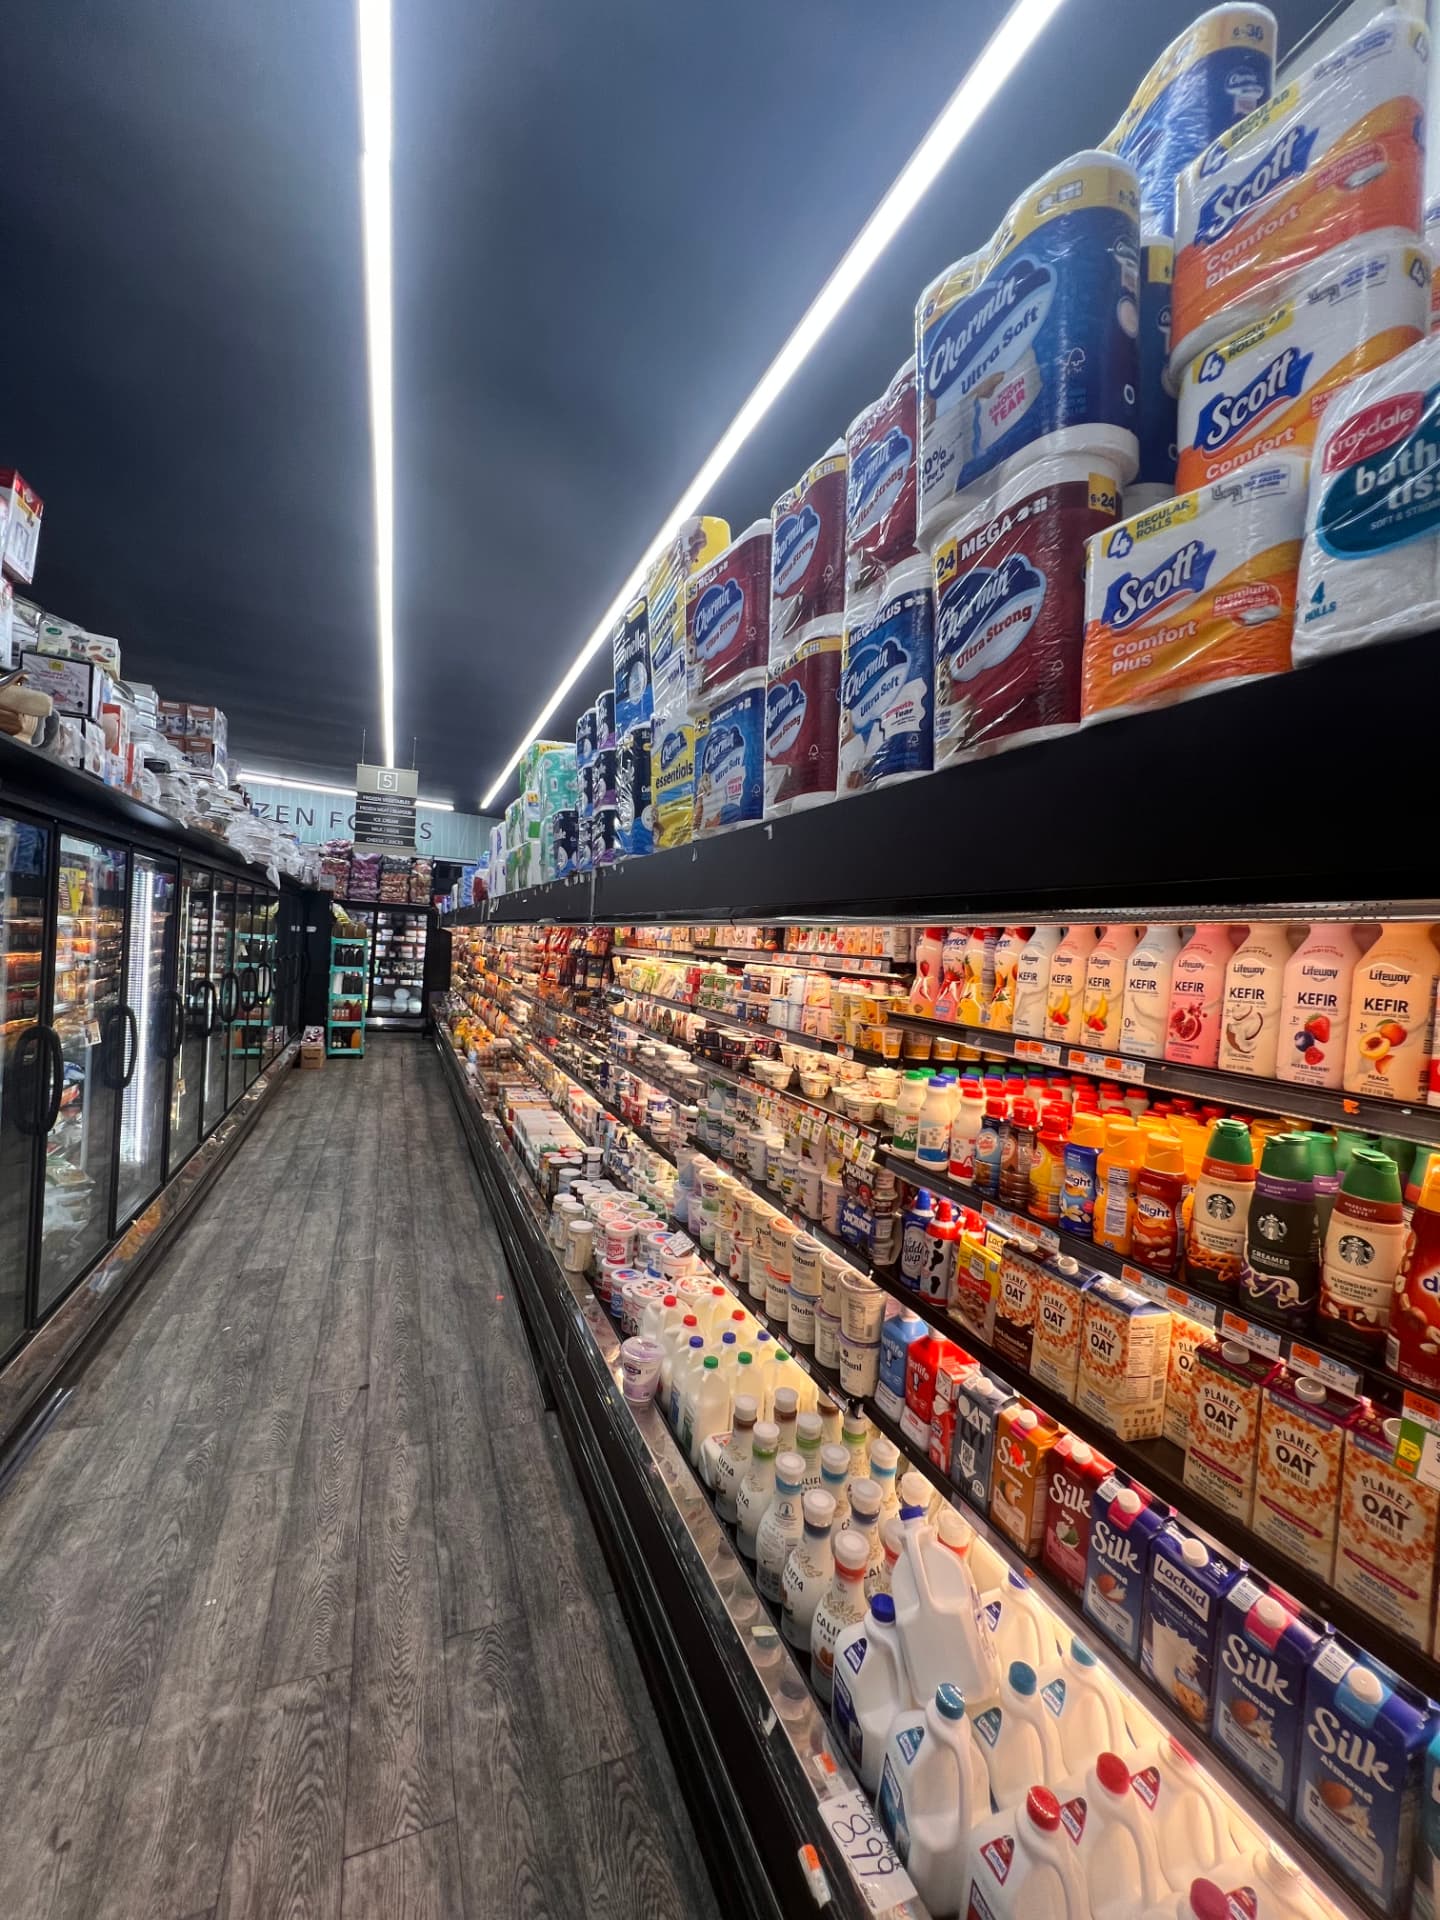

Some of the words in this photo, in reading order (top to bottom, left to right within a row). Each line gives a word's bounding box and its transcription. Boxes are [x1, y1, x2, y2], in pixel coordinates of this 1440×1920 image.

[1200, 140, 1227, 178] 4
[1206, 128, 1300, 236] Scott
[1206, 206, 1299, 271] Comfort
[1410, 257, 1426, 288] 4
[929, 277, 1017, 391] Charmin
[1228, 331, 1266, 359] ROLLS
[961, 350, 1001, 395] Ultra
[1002, 305, 1039, 349] Soft
[1199, 350, 1226, 383] 4
[991, 391, 1025, 427] TEAR
[1206, 347, 1295, 445] Scott
[1326, 404, 1416, 464] Krasdale
[923, 447, 947, 474] 0%
[1205, 426, 1296, 479] Comfort
[1356, 437, 1437, 496] bath
[1136, 499, 1190, 530] REGULAR
[1136, 515, 1173, 540] ROLLS
[1370, 516, 1393, 531] SOFT
[935, 552, 956, 580] 24
[961, 514, 1013, 561] MEGA
[1107, 526, 1134, 559] 4
[1113, 543, 1200, 624] Scott
[1215, 584, 1271, 604] Premium
[1310, 581, 1326, 605] 4
[1304, 600, 1337, 623] ROLLS
[956, 640, 985, 670] Ultra
[986, 605, 1033, 643] Strong
[1112, 620, 1198, 659] Comfort
[845, 647, 889, 705] Charmin
[1111, 655, 1153, 677] Plus
[860, 691, 880, 717] Ultra
[880, 675, 900, 697] Soft
[655, 760, 694, 790] essentials
[255, 802, 315, 827] ZEN
[1018, 971, 1038, 982] KEFIR
[1051, 974, 1073, 985] KEFIR
[1088, 977, 1111, 988] KEFIR
[1129, 978, 1158, 991] KEFIR
[1174, 981, 1205, 994] KEFIR
[1229, 987, 1266, 1001] KEFIR
[1297, 991, 1338, 1008] KEFIR
[1363, 997, 1409, 1014] KEFIR
[1367, 1074, 1389, 1083] PEACH
[1139, 1202, 1172, 1217] elight
[1252, 1249, 1291, 1266] CREAMER
[1005, 1272, 1028, 1289] PLANET
[1005, 1284, 1026, 1303] OAT
[1043, 1295, 1068, 1313] PLANET
[1043, 1307, 1066, 1328] OAT
[1090, 1320, 1118, 1341] PLANET
[1090, 1333, 1115, 1356] OAT
[1203, 1387, 1243, 1414] PLANET
[1204, 1402, 1239, 1431] OAT
[1274, 1427, 1321, 1459] PLANET
[1275, 1444, 1317, 1479] OAT
[1050, 1473, 1093, 1519] Silk
[1209, 1470, 1244, 1499] creamy
[1360, 1474, 1415, 1511] PLANET
[1361, 1493, 1412, 1532] OAT
[1091, 1520, 1142, 1574] Silk
[1097, 1555, 1128, 1586] Almond
[1156, 1558, 1207, 1610] Lactaid
[1221, 1633, 1295, 1706] Silk
[1231, 1675, 1276, 1719] Almond
[1306, 1706, 1396, 1793] Silk
[1319, 1754, 1374, 1806] Almond
